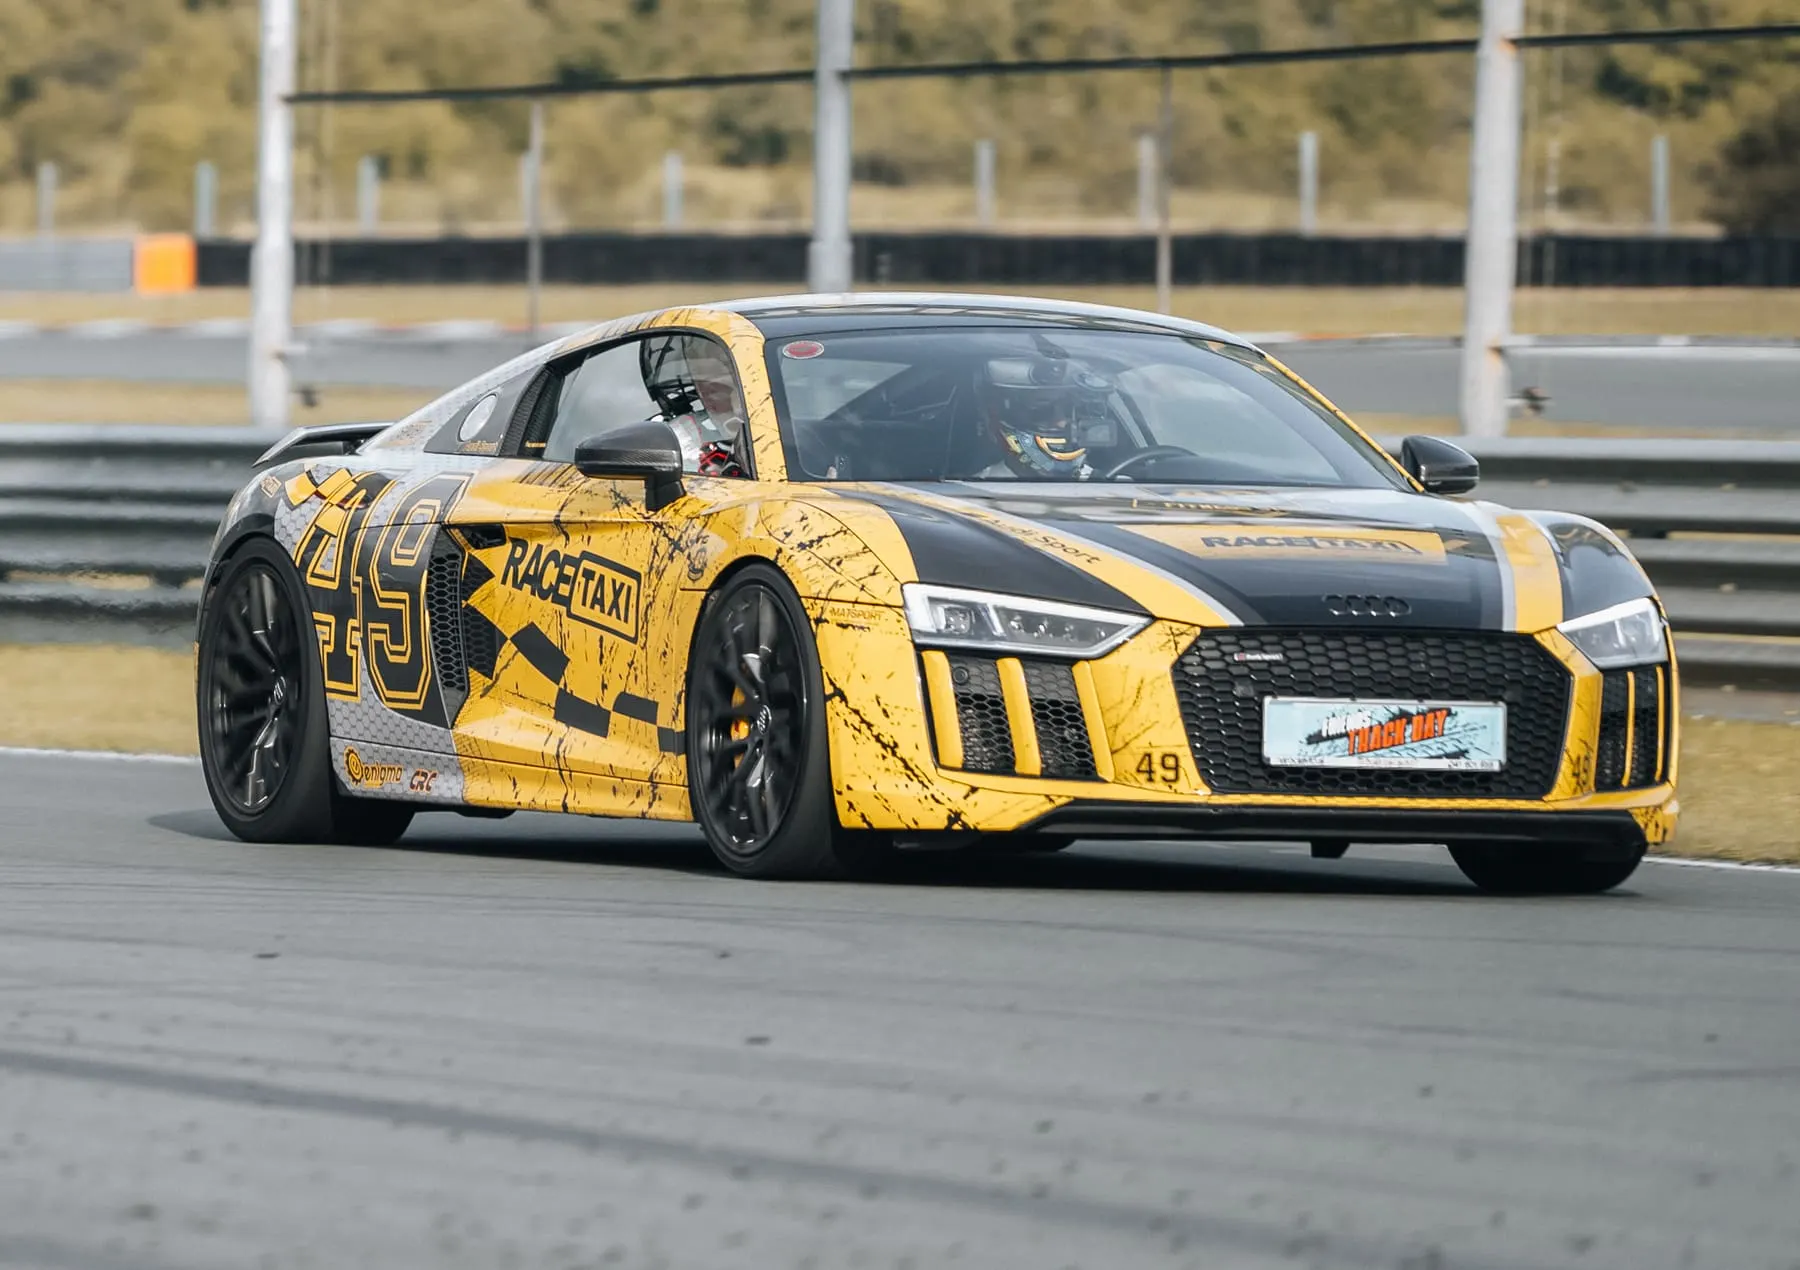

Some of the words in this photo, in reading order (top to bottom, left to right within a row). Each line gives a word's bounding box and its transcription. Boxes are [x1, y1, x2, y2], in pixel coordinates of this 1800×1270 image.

[1034, 534, 1102, 565] Sport
[1200, 536, 1317, 548] RACE
[1313, 538, 1404, 551] TAXI
[295, 471, 480, 711] 49
[501, 536, 576, 607] RACE
[581, 567, 633, 624] TAXI
[1348, 717, 1407, 755] TRACK
[1411, 708, 1448, 743] DAY
[363, 762, 403, 786] enigma
[409, 769, 438, 793] CRC
[1136, 751, 1180, 784] 49
